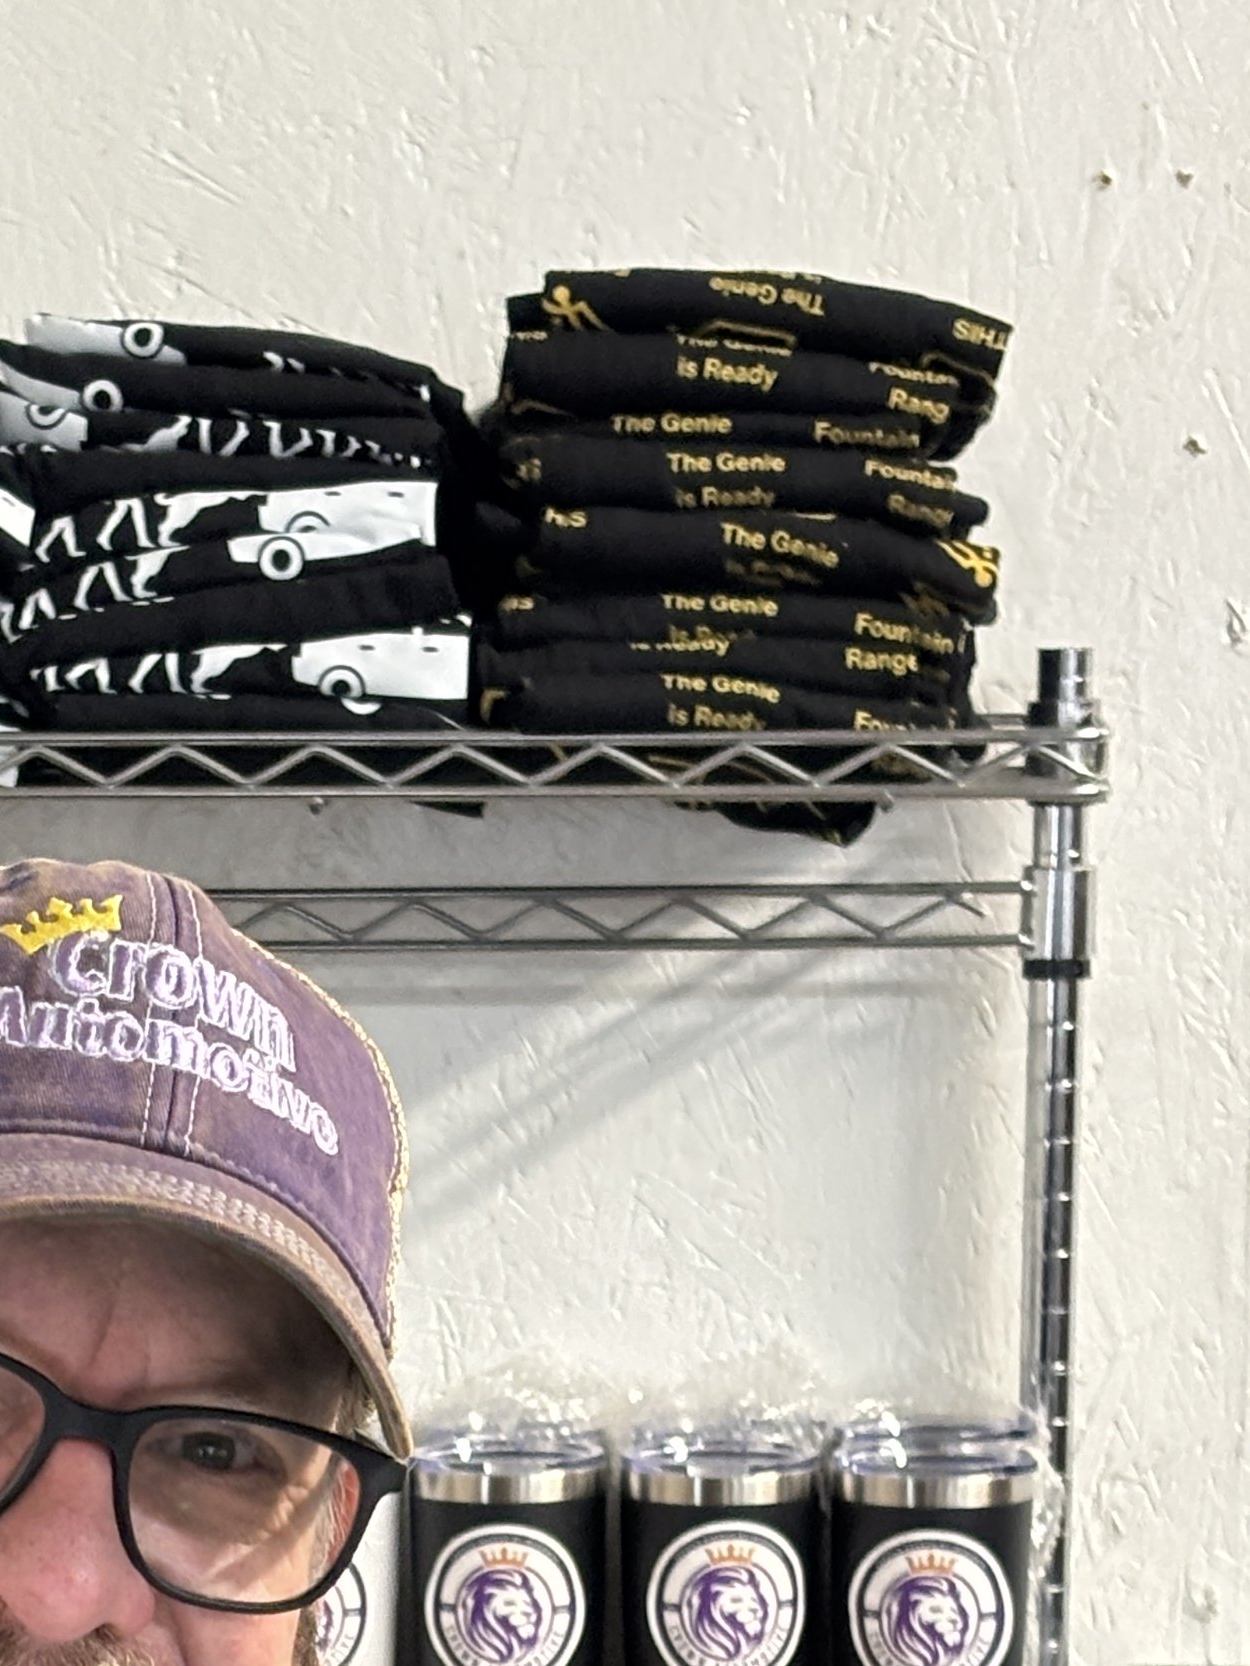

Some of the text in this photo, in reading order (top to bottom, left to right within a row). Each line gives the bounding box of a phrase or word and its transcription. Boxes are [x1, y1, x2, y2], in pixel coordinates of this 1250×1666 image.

[780, 286, 825, 316] The
[702, 356, 779, 393] Ready
[611, 412, 733, 434] The Genie
[665, 452, 786, 473] The Genie
[720, 521, 840, 568] The Genie
[660, 593, 779, 617] The Genie
[660, 673, 781, 703] The Genie
[48, 929, 297, 1072] Crown
